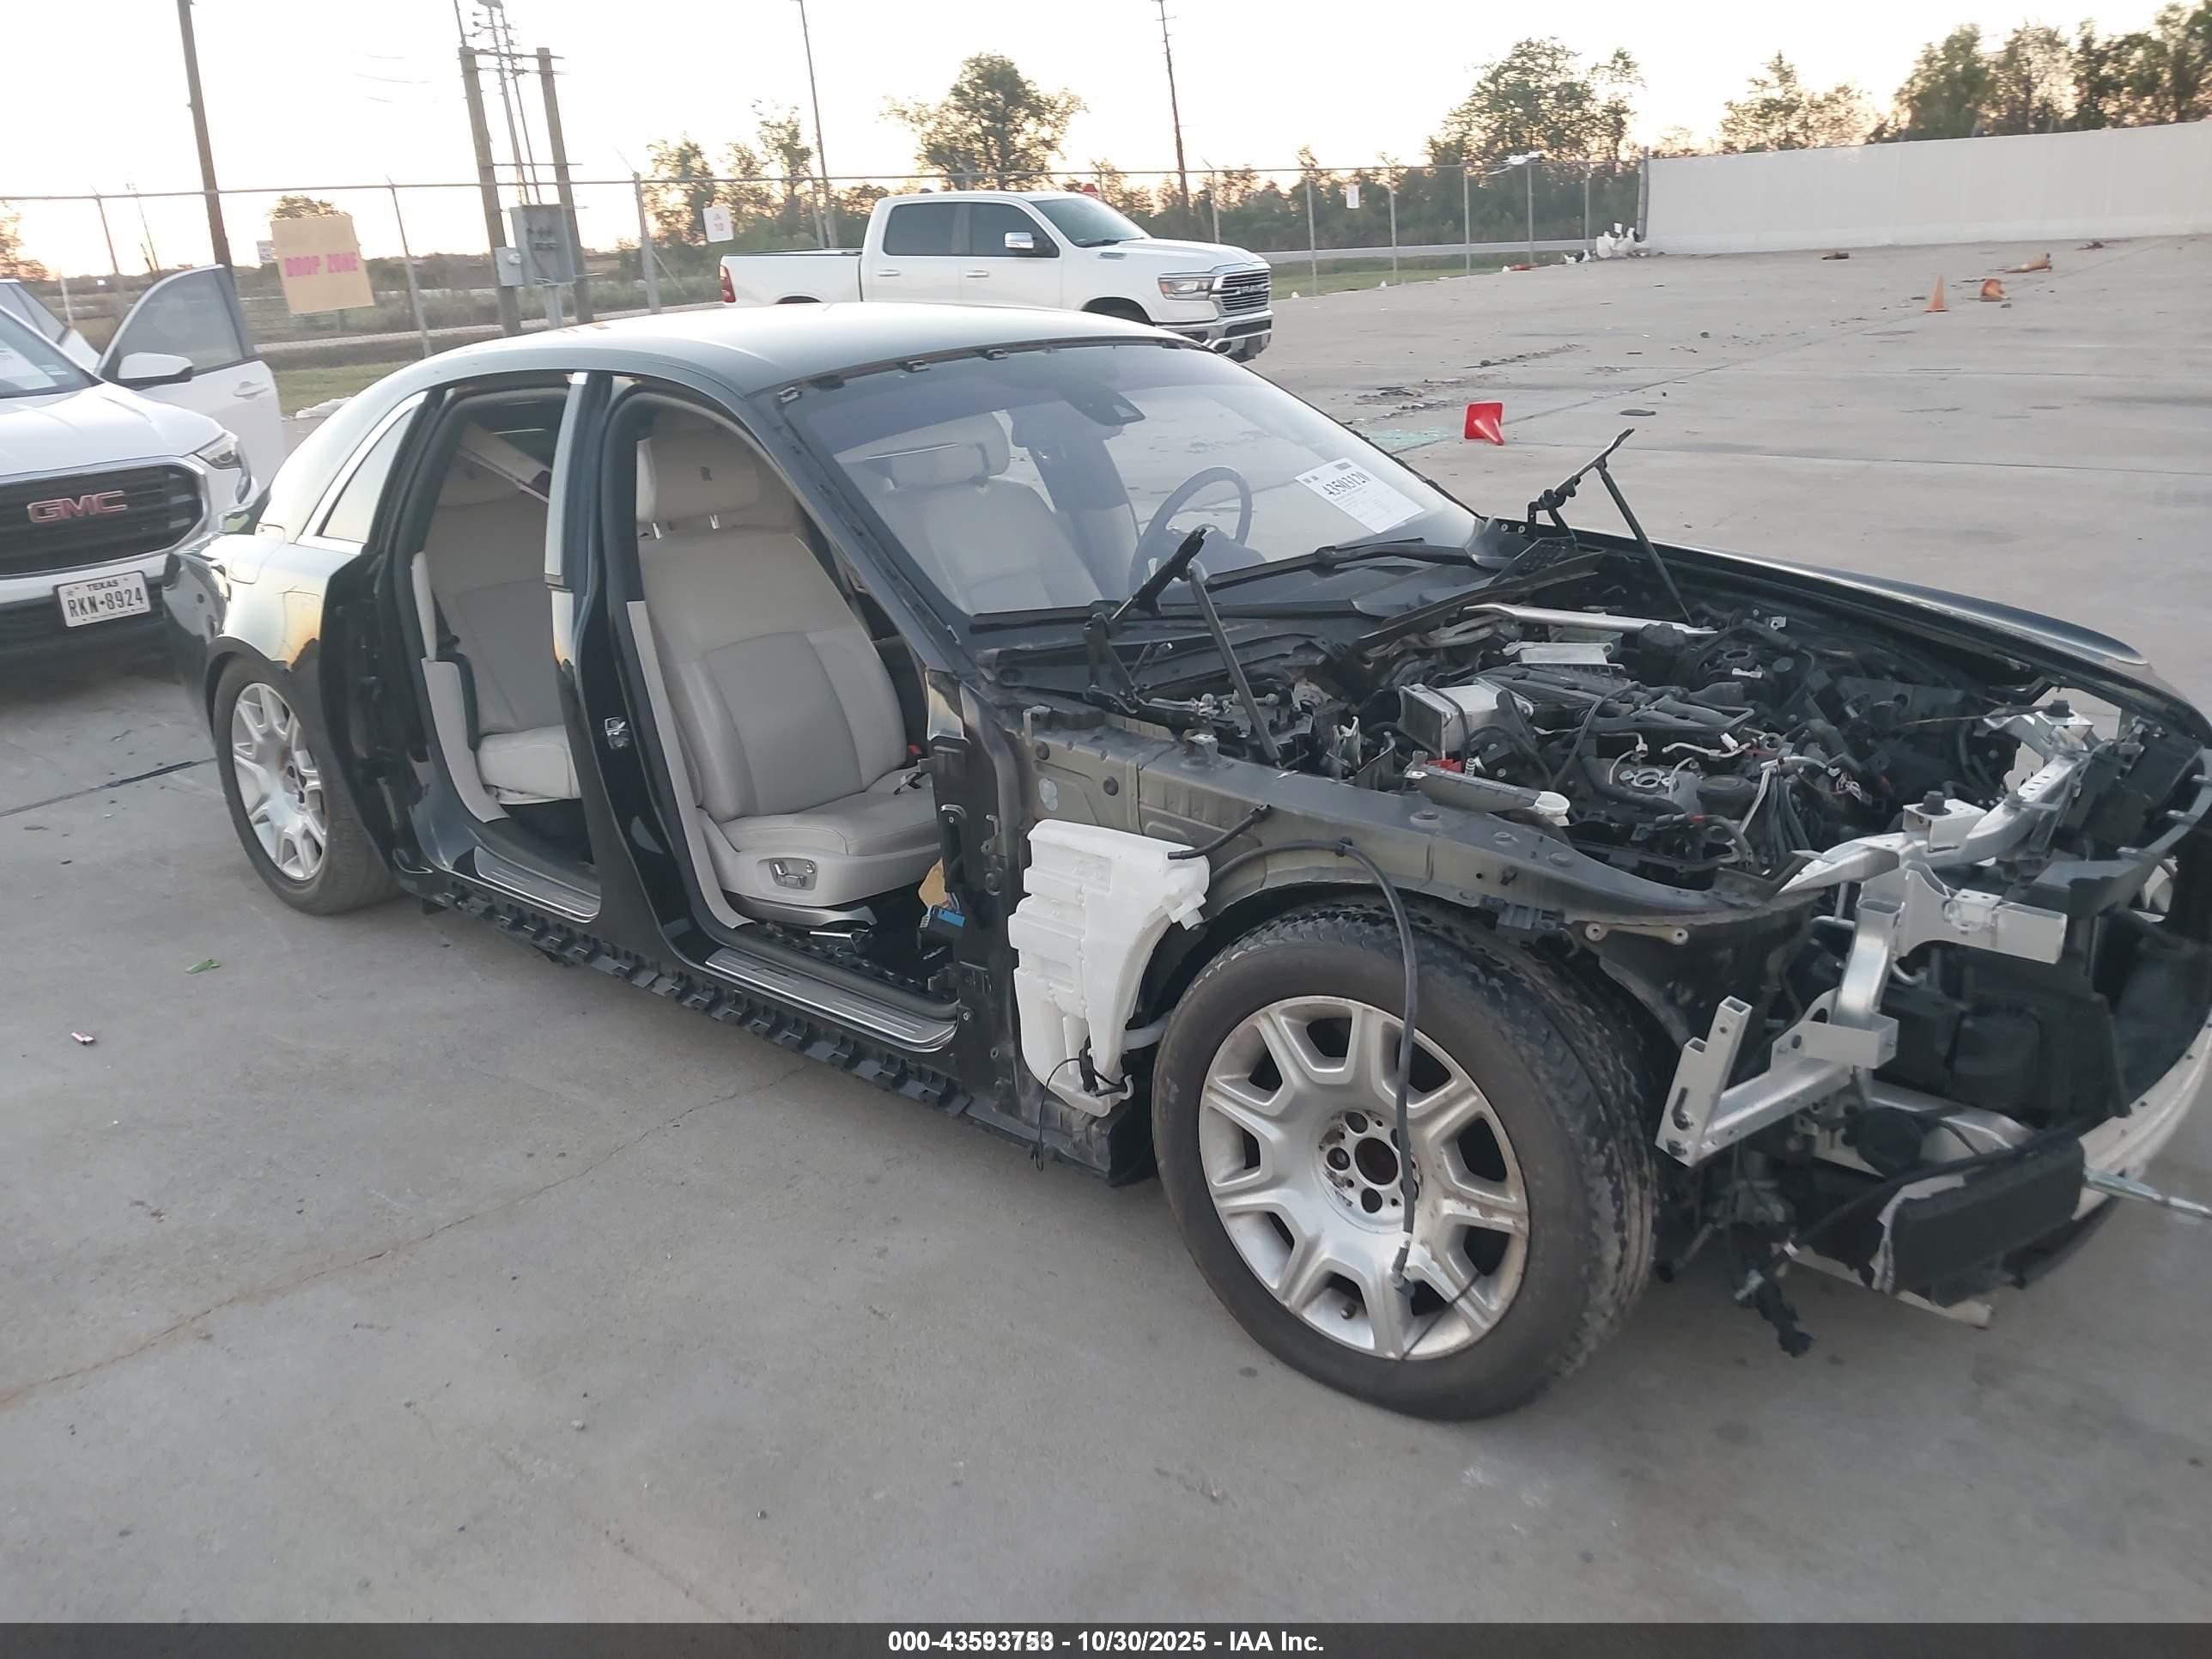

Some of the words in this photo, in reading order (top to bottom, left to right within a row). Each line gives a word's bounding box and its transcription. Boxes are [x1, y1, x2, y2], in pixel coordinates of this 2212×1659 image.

[285, 255, 320, 277] DROP
[327, 252, 358, 274] ZONE
[27, 490, 127, 523] GMC
[86, 579, 118, 592] TEXAS
